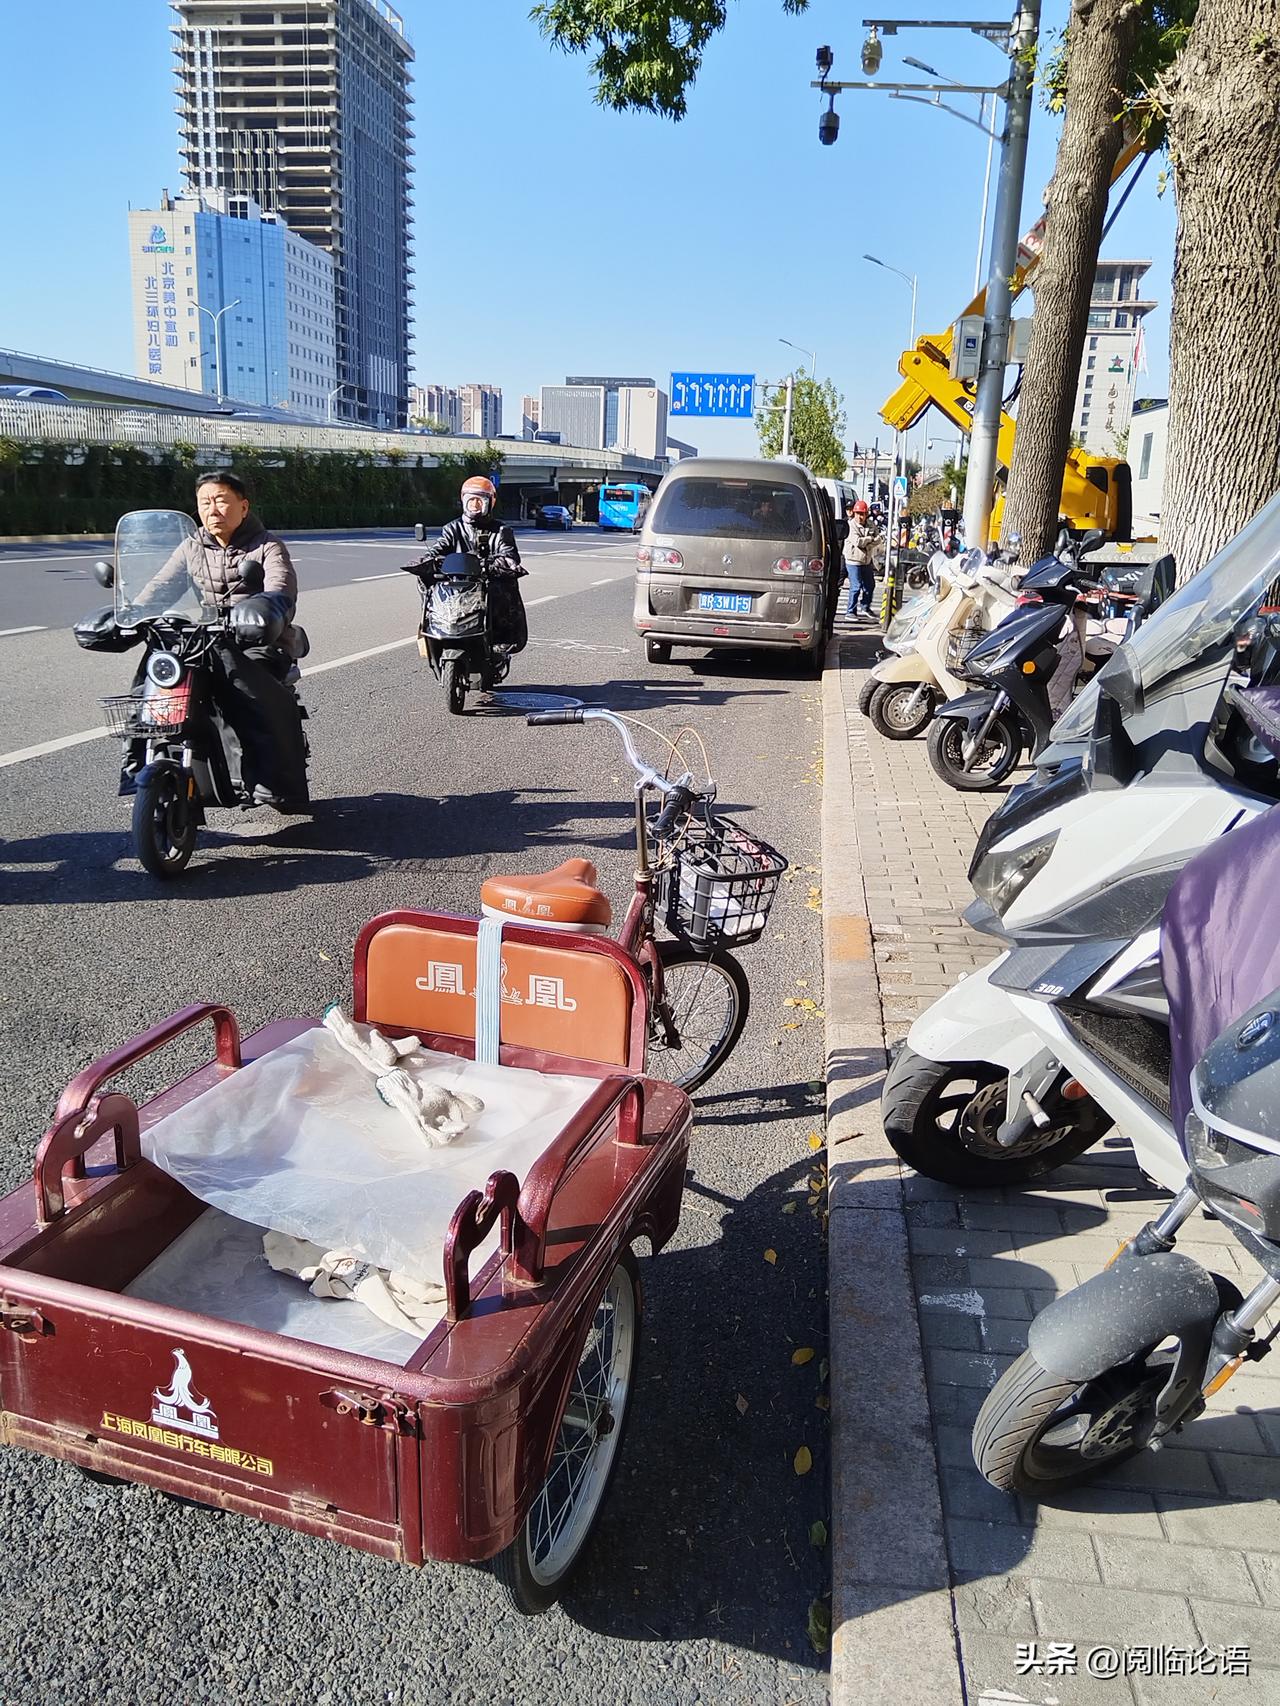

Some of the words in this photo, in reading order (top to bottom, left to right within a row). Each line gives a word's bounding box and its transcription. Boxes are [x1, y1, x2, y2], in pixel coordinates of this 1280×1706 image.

[144, 276, 162, 375] 北三环妇儿医院
[162, 261, 178, 347] 北京美中宜和
[1034, 983, 1064, 995] 300
[101, 1412, 273, 1477] 上海凤凰自行车有限公司
